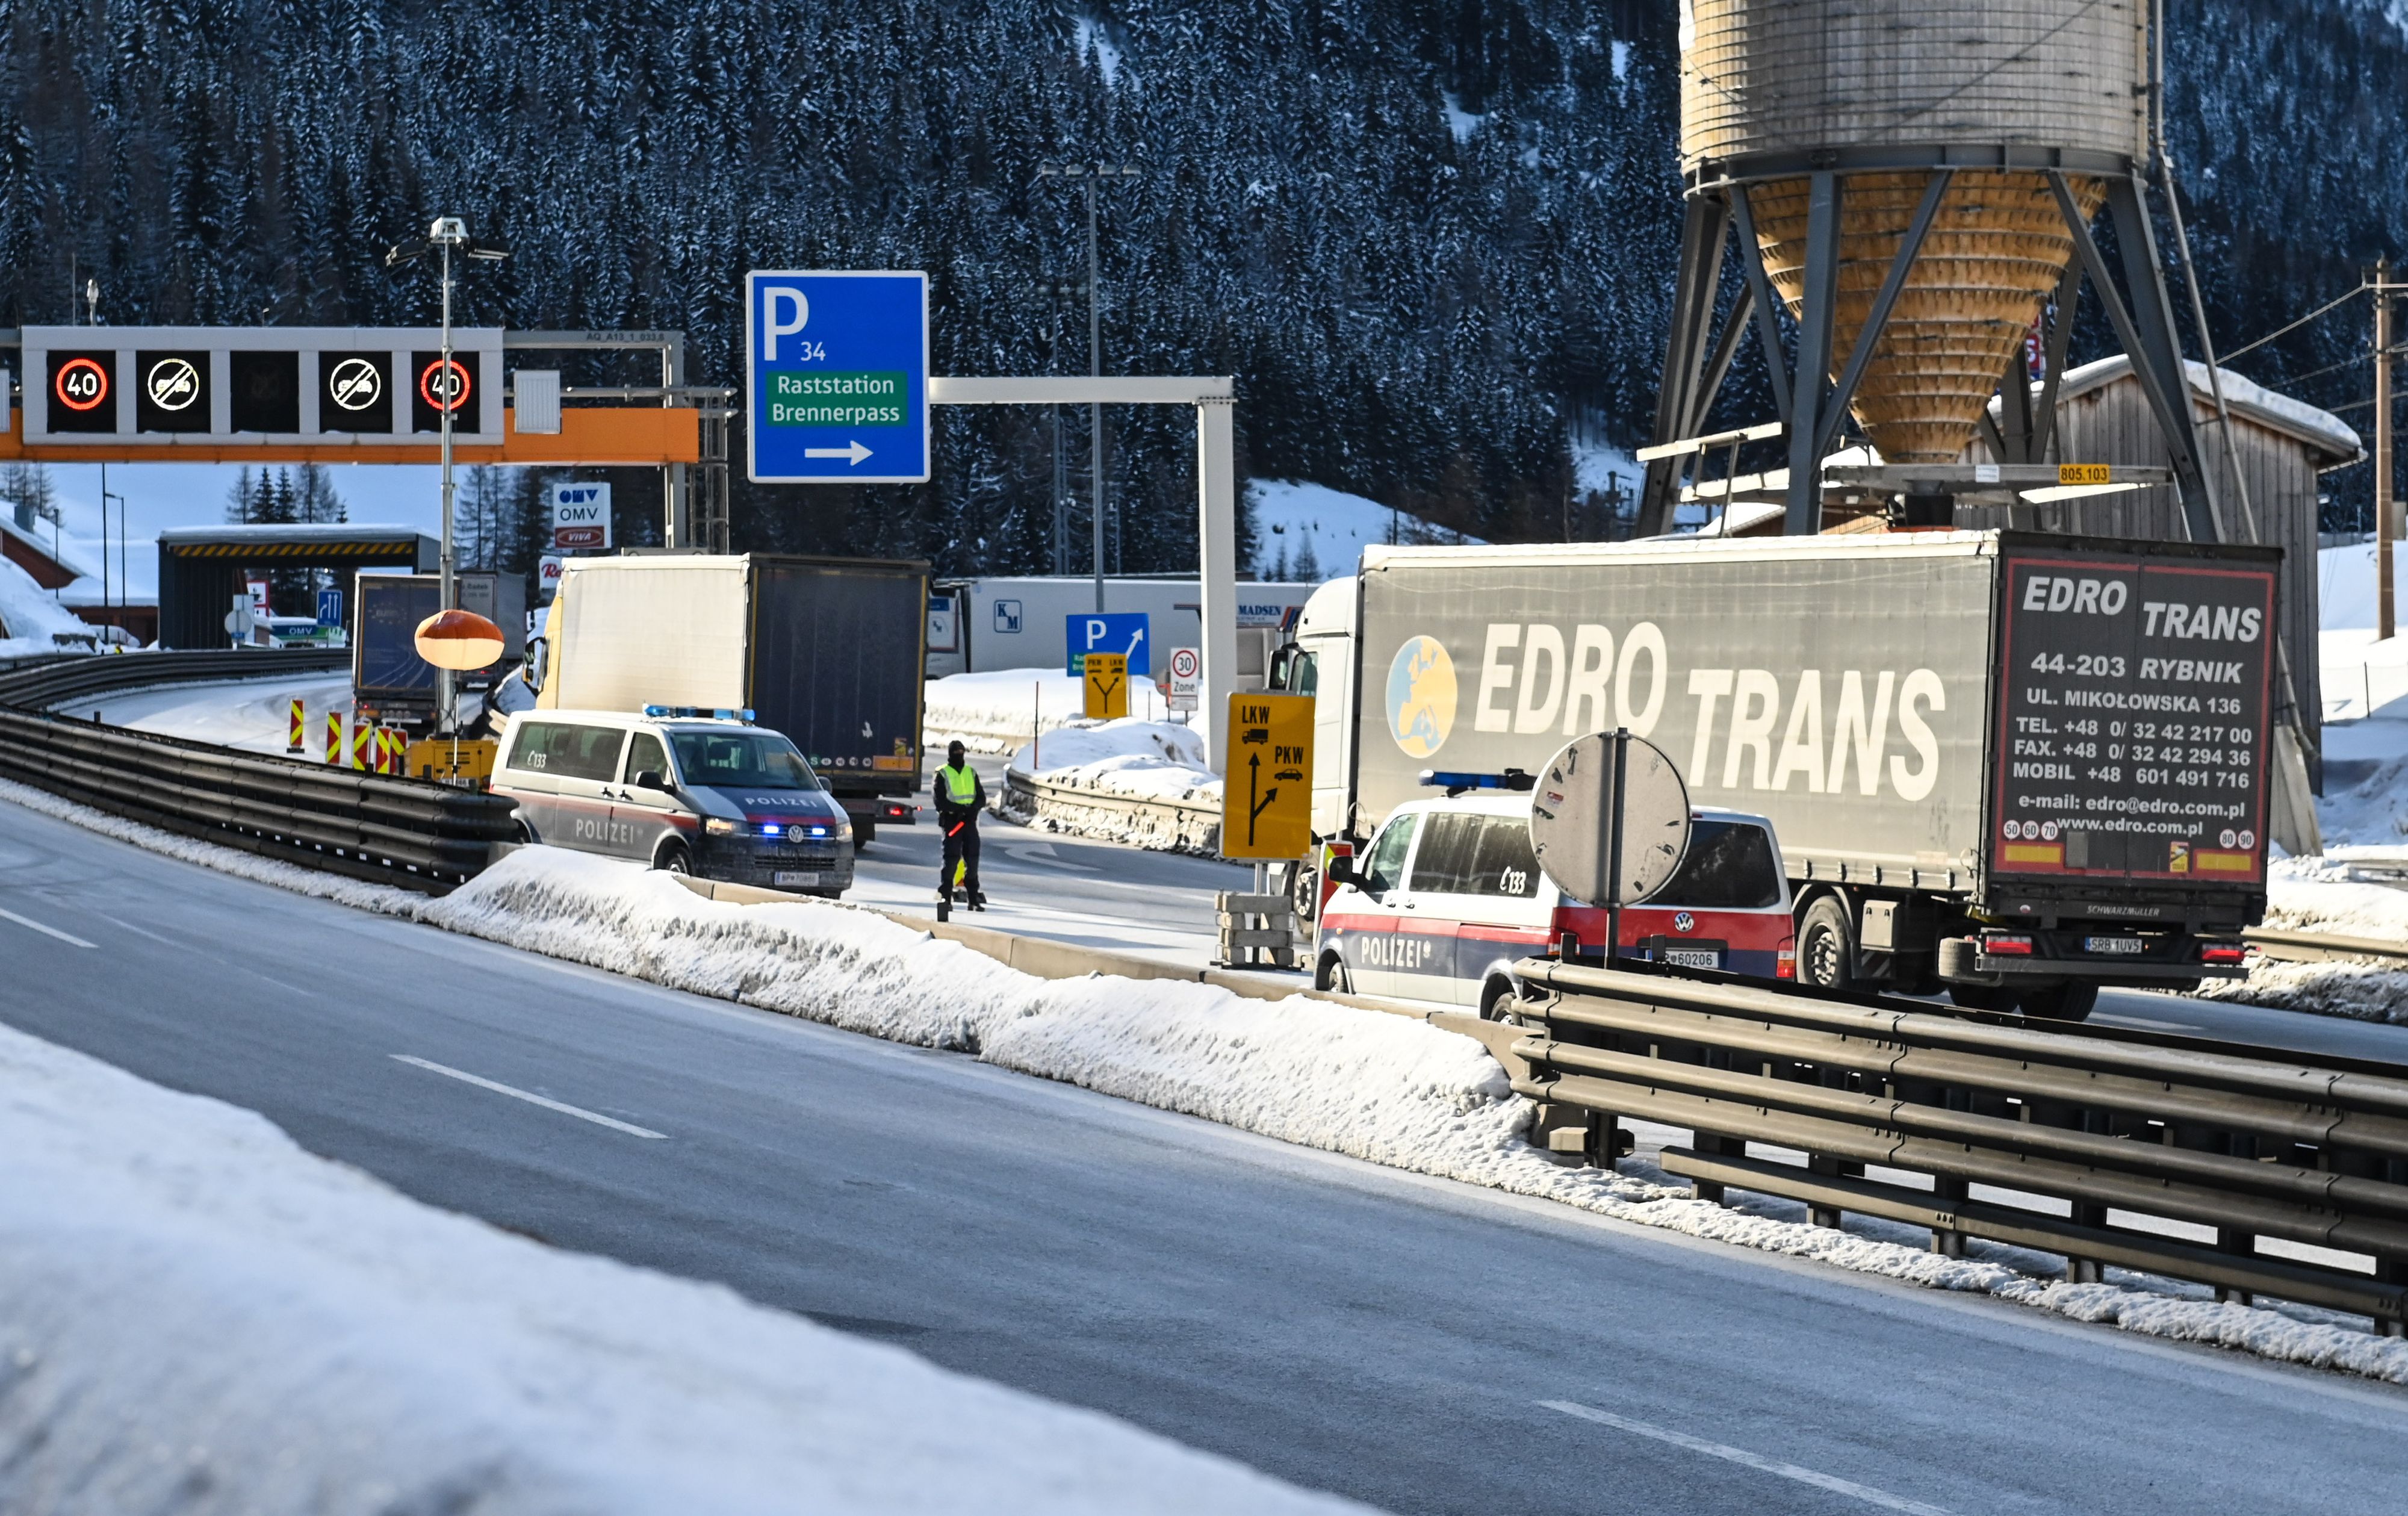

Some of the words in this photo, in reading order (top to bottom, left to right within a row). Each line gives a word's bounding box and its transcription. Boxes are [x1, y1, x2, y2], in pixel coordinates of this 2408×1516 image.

[764, 287, 809, 361] P
[801, 341, 826, 361] 34
[67, 373, 97, 396] 40
[432, 374, 460, 396] 40
[778, 375, 894, 394] Raststation
[772, 403, 900, 426] Brennerpass
[2061, 468, 2107, 481] 805.103
[560, 508, 598, 521] OMV
[568, 533, 591, 541] VIVA
[2023, 576, 2127, 615] EDRO
[1238, 605, 1281, 615] MADSEN
[2143, 601, 2262, 642] TRANS
[1087, 620, 1106, 650] P
[1178, 657, 1191, 671] 30
[2031, 652, 2125, 677] 44-203
[2140, 658, 2244, 684] RYBNIK
[1174, 682, 1195, 692] Zone
[1474, 622, 1668, 738] EDRO
[2026, 688, 2058, 705] UL.
[2065, 690, 2200, 713] MIKOŁOWSKA
[2206, 698, 2241, 715] 136
[1242, 705, 1270, 724] LKW
[1686, 668, 1946, 802] TRANS
[2015, 716, 2058, 735] TEL.
[2064, 720, 2099, 736] +48
[2133, 723, 2155, 739] 32
[2161, 724, 2184, 741] 42
[2189, 725, 2224, 742] 217
[2229, 727, 2251, 744] 00
[533, 753, 547, 769] 133
[1274, 745, 1303, 765] PKW
[2014, 739, 2056, 757] FAX.
[2063, 742, 2097, 759] +48
[2132, 746, 2155, 762] 32
[2159, 747, 2183, 763] 42
[2188, 748, 2223, 765] 294
[2228, 750, 2251, 766] 36
[2013, 762, 2076, 780] MOBIL
[2087, 766, 2121, 782] +48
[2135, 768, 2168, 784] 601
[2175, 770, 2208, 787] 491
[2215, 772, 2250, 789] 716
[745, 797, 818, 808] POLIZEI
[2019, 794, 2080, 810] e-mail:
[2085, 797, 2245, 819] edro@edro.com.pl
[576, 819, 633, 843] POLIZEI
[2006, 824, 2018, 835] 50
[2025, 824, 2037, 836] 60
[2044, 825, 2056, 837] 70
[2056, 818, 2203, 837] www.edro.com.pl
[2222, 833, 2233, 845] 80
[2241, 834, 2251, 845] 90
[1508, 871, 1527, 894] 133
[1361, 936, 1421, 968] POLIZEI
[2092, 939, 2111, 949] SRB
[1678, 953, 1712, 966] 60206
